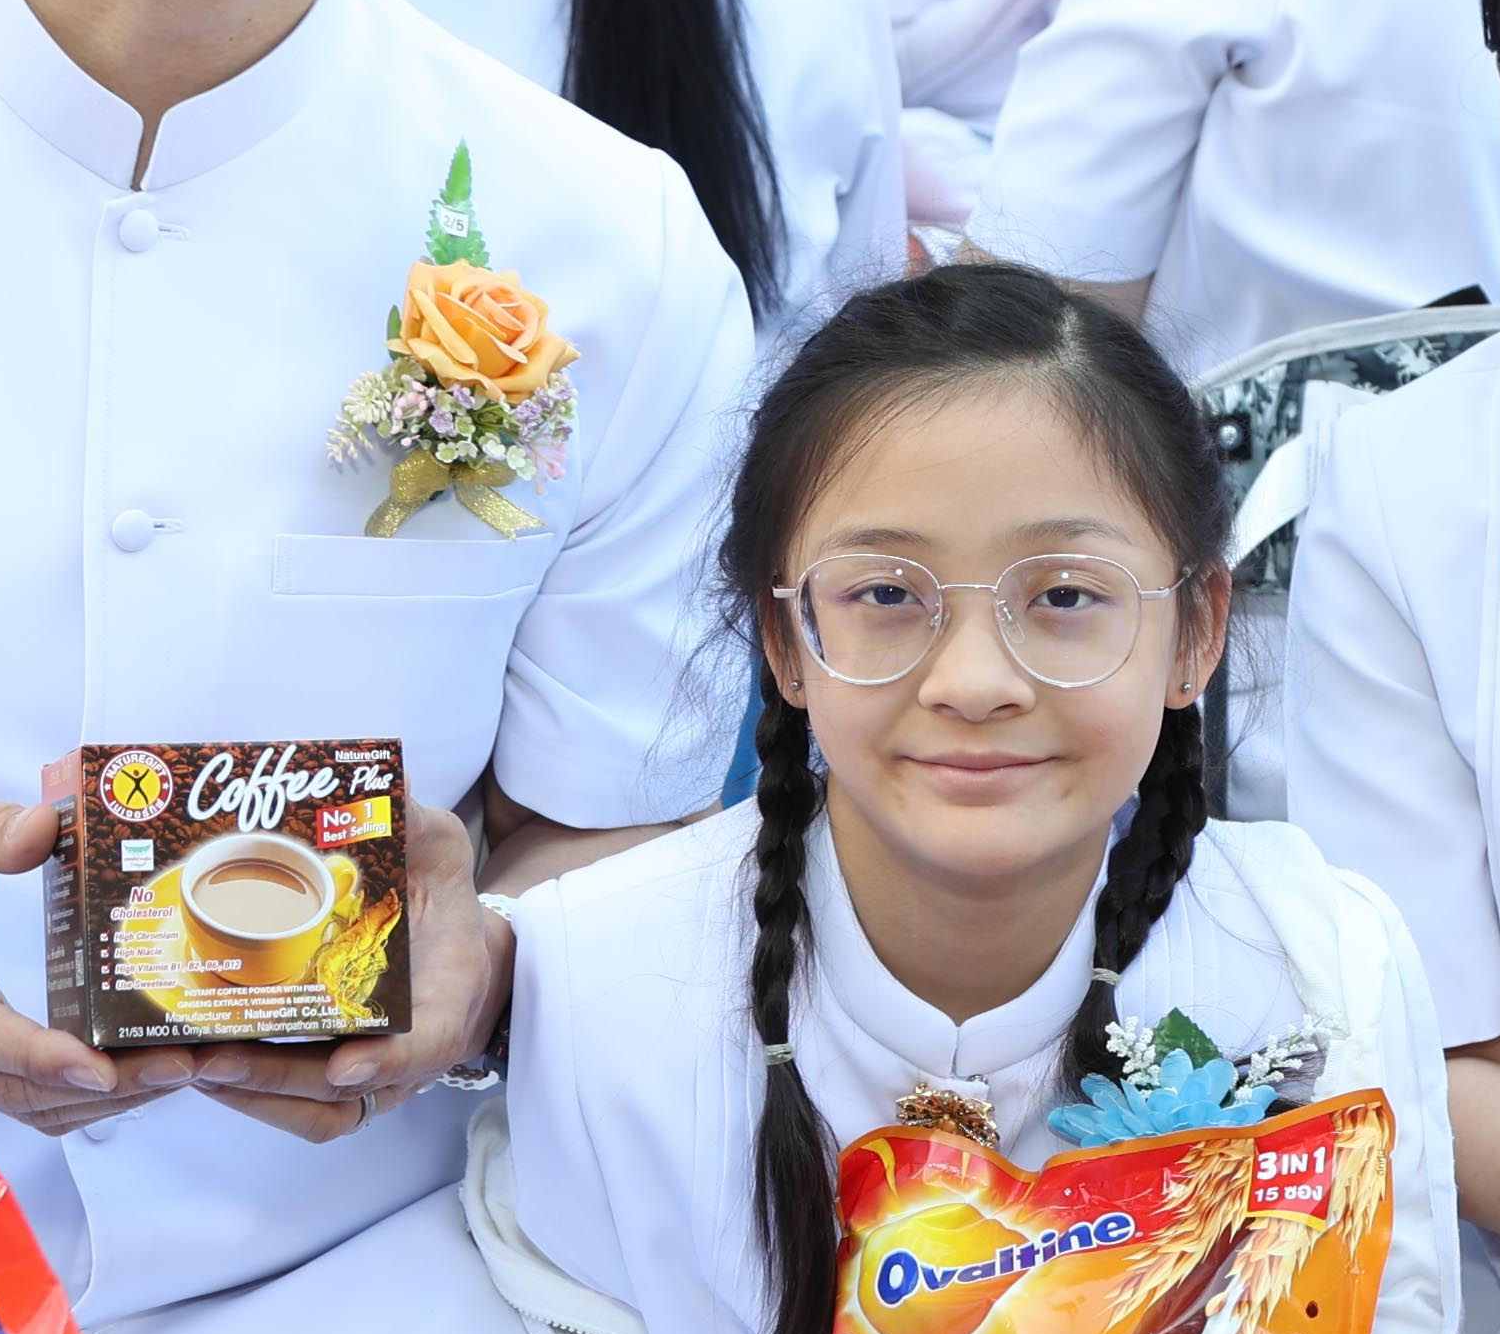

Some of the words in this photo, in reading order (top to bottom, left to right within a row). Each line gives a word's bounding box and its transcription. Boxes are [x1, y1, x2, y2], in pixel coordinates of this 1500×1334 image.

[335, 749, 391, 762] NatureGift
[106, 753, 167, 778] NATUREGIFT
[187, 744, 340, 832] Coffee
[350, 764, 394, 795] Plus
[323, 810, 357, 828] No.
[364, 802, 372, 818] 1
[323, 830, 348, 843] Best
[350, 821, 387, 837] Selling
[130, 887, 154, 904] No
[111, 907, 174, 920] Cholesterol
[114, 932, 134, 942] High
[137, 931, 179, 941] Chromium
[115, 949, 135, 958] High
[137, 948, 163, 956] Niacin
[115, 965, 135, 975] High
[138, 964, 169, 973] Vitamin
[115, 980, 132, 990] Use
[217, 987, 248, 996] COFFEE
[249, 985, 283, 995] POWDER
[283, 985, 303, 994] WITH
[303, 984, 325, 993] FIBER
[165, 1011, 233, 1023] Manufacturer
[243, 1006, 298, 1019] NatureGift
[118, 1027, 144, 1038] 21/53
[146, 1025, 170, 1037] MOO
[355, 1016, 389, 1028] Thailand
[1256, 1151, 1279, 1181] 3
[1280, 1155, 1308, 1176] IN
[1312, 1146, 1326, 1174] 1
[1254, 1189, 1279, 1203] 15
[1284, 1185, 1324, 1202] ซอง
[876, 1211, 1136, 1308] Ovaltine
